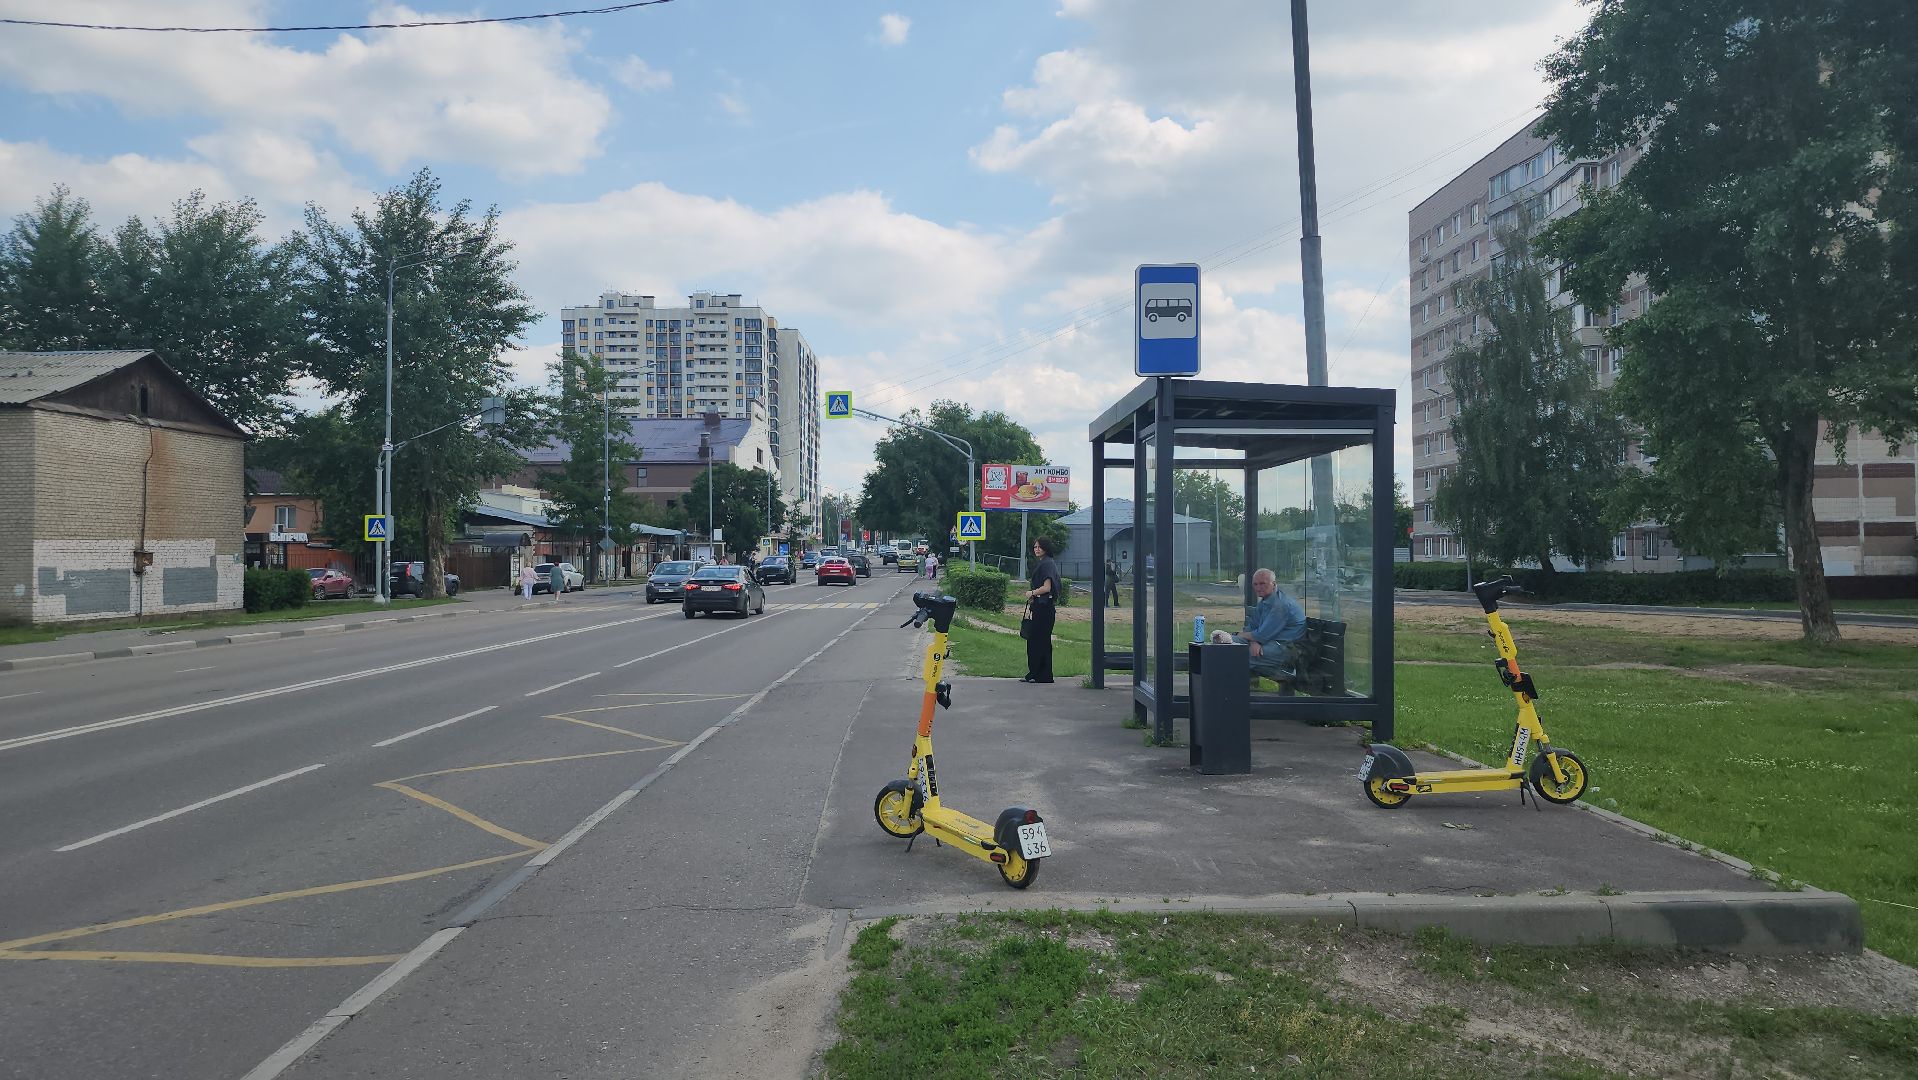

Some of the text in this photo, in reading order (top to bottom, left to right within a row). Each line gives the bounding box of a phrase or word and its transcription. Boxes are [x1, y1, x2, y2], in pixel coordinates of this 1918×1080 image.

[1047, 468, 1069, 476] КОМБО
[1021, 826, 1043, 841] 594
[1026, 841, 1047, 856] 336
